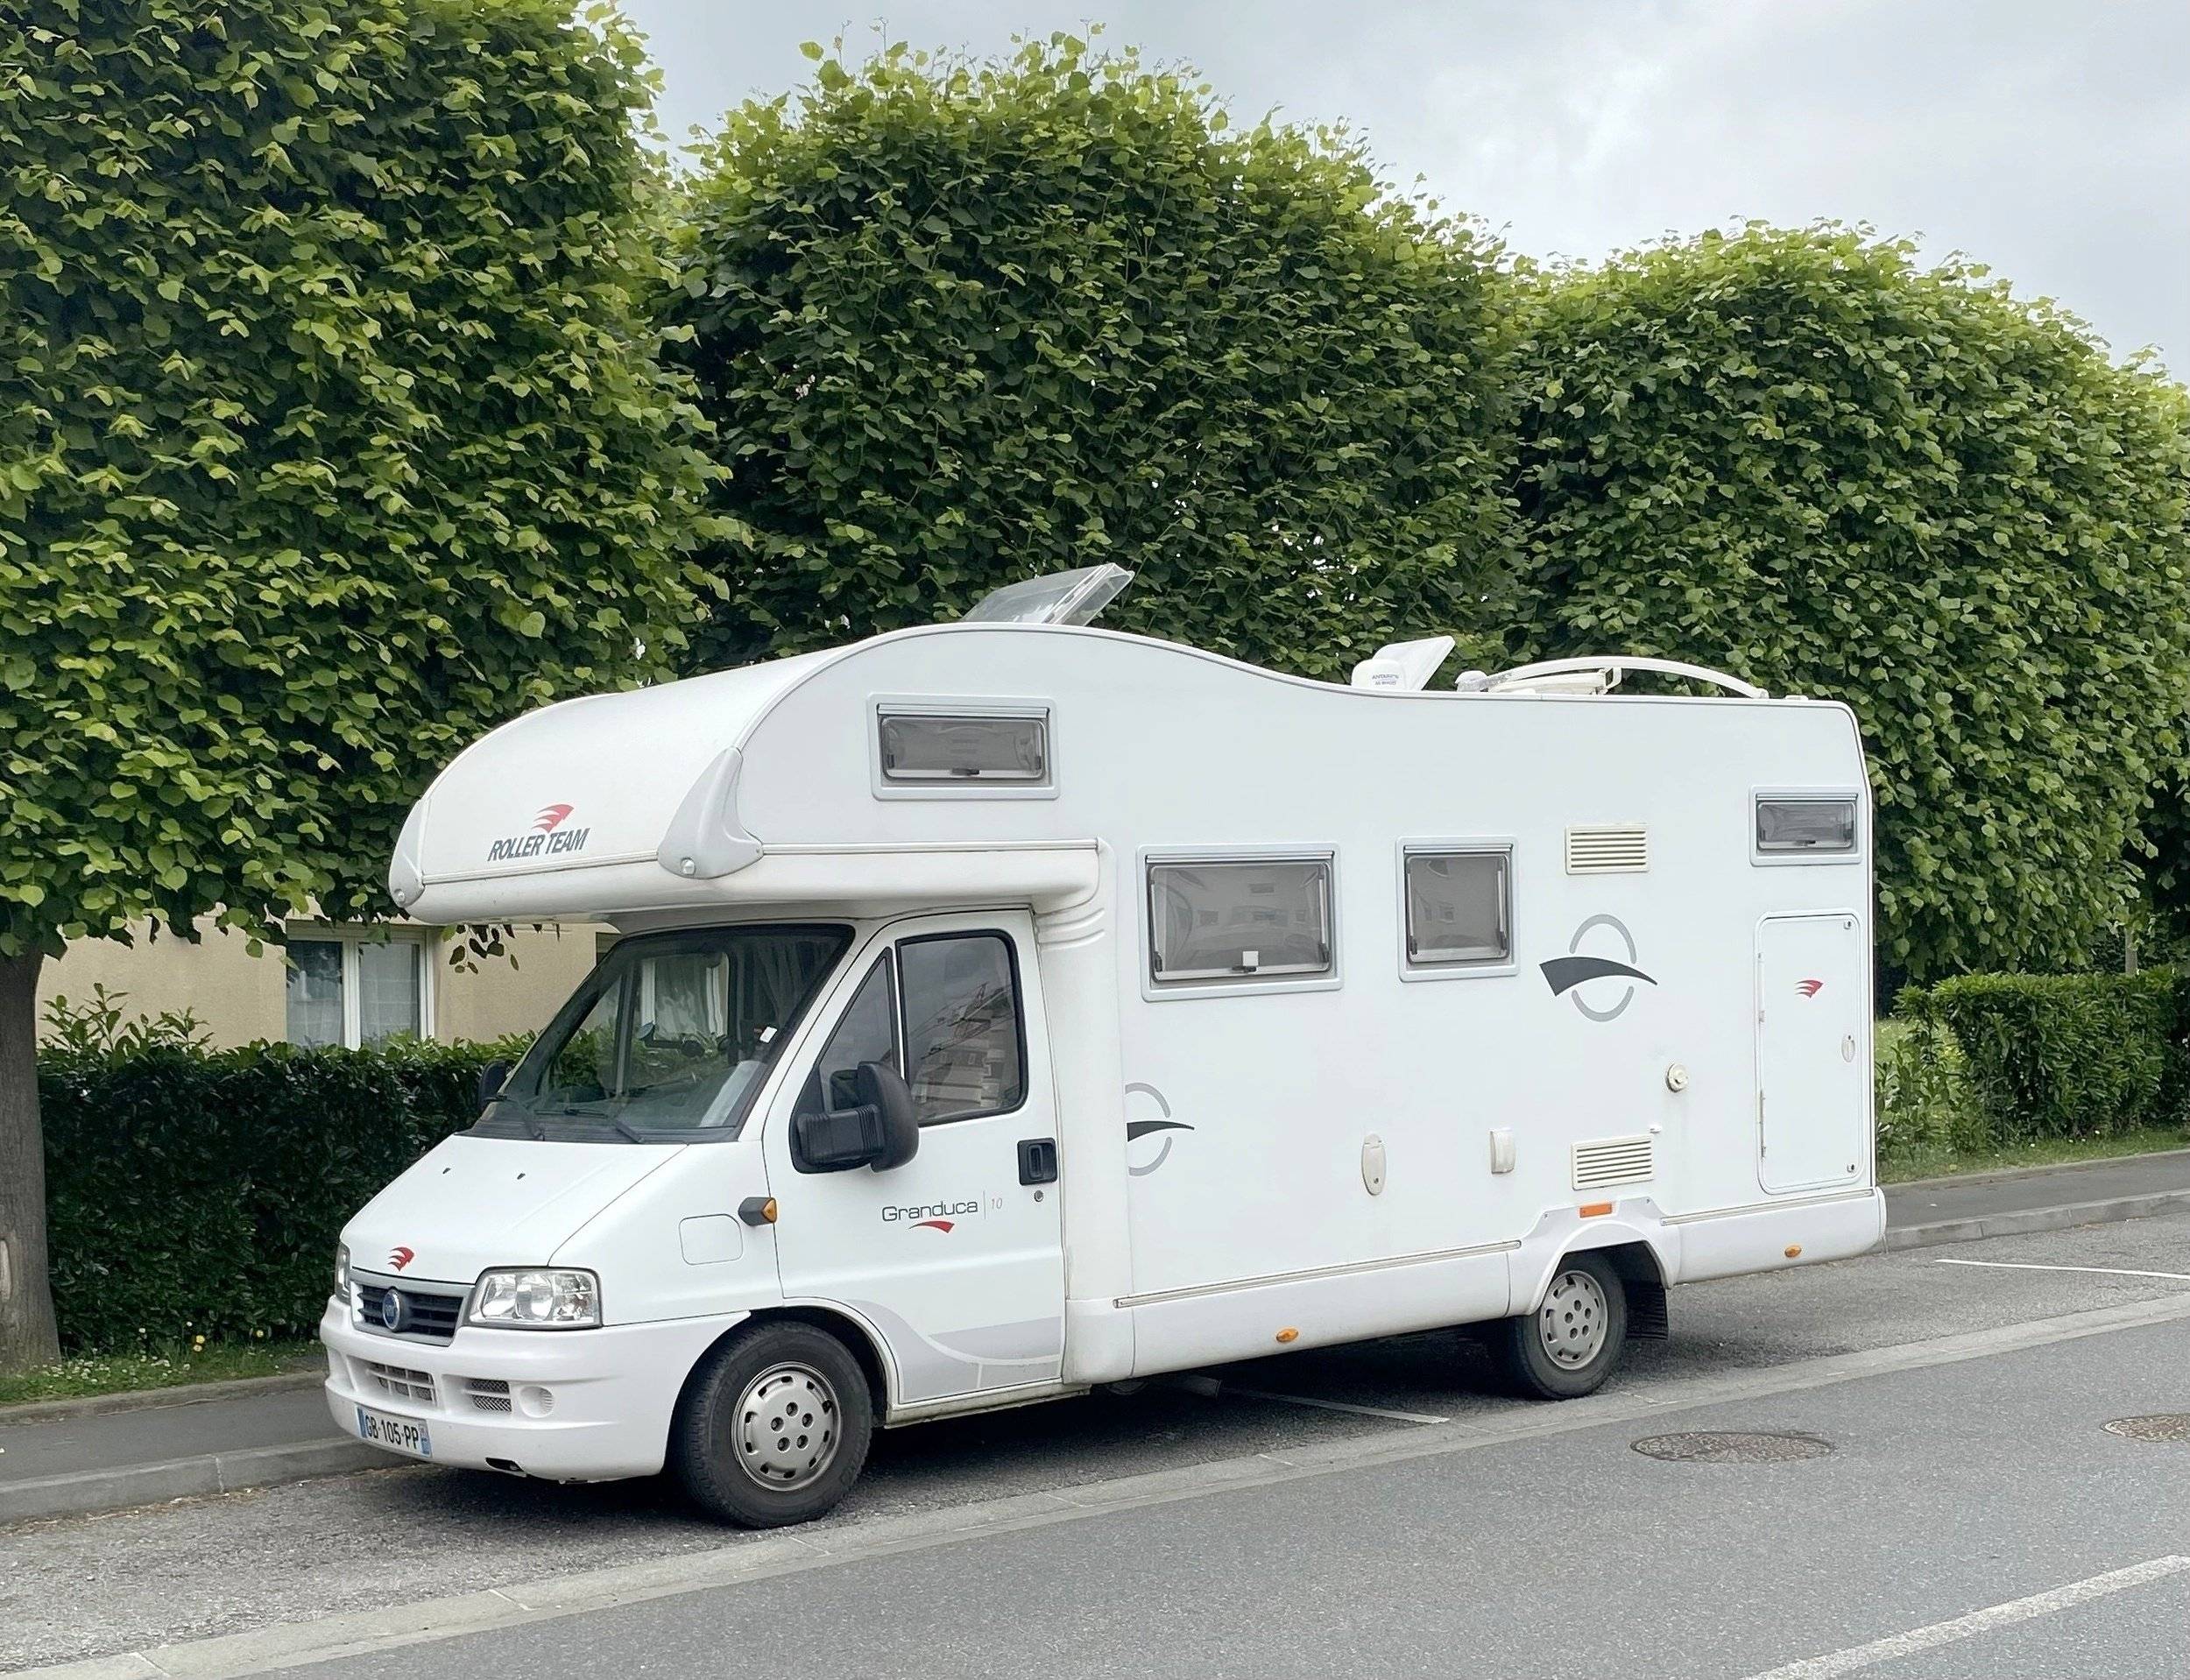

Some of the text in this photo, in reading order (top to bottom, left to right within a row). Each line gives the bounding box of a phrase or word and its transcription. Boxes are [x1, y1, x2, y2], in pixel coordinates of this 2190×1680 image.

[487, 828, 590, 861] ROLLER TEAM
[881, 1197, 1003, 1221] Granduca 10
